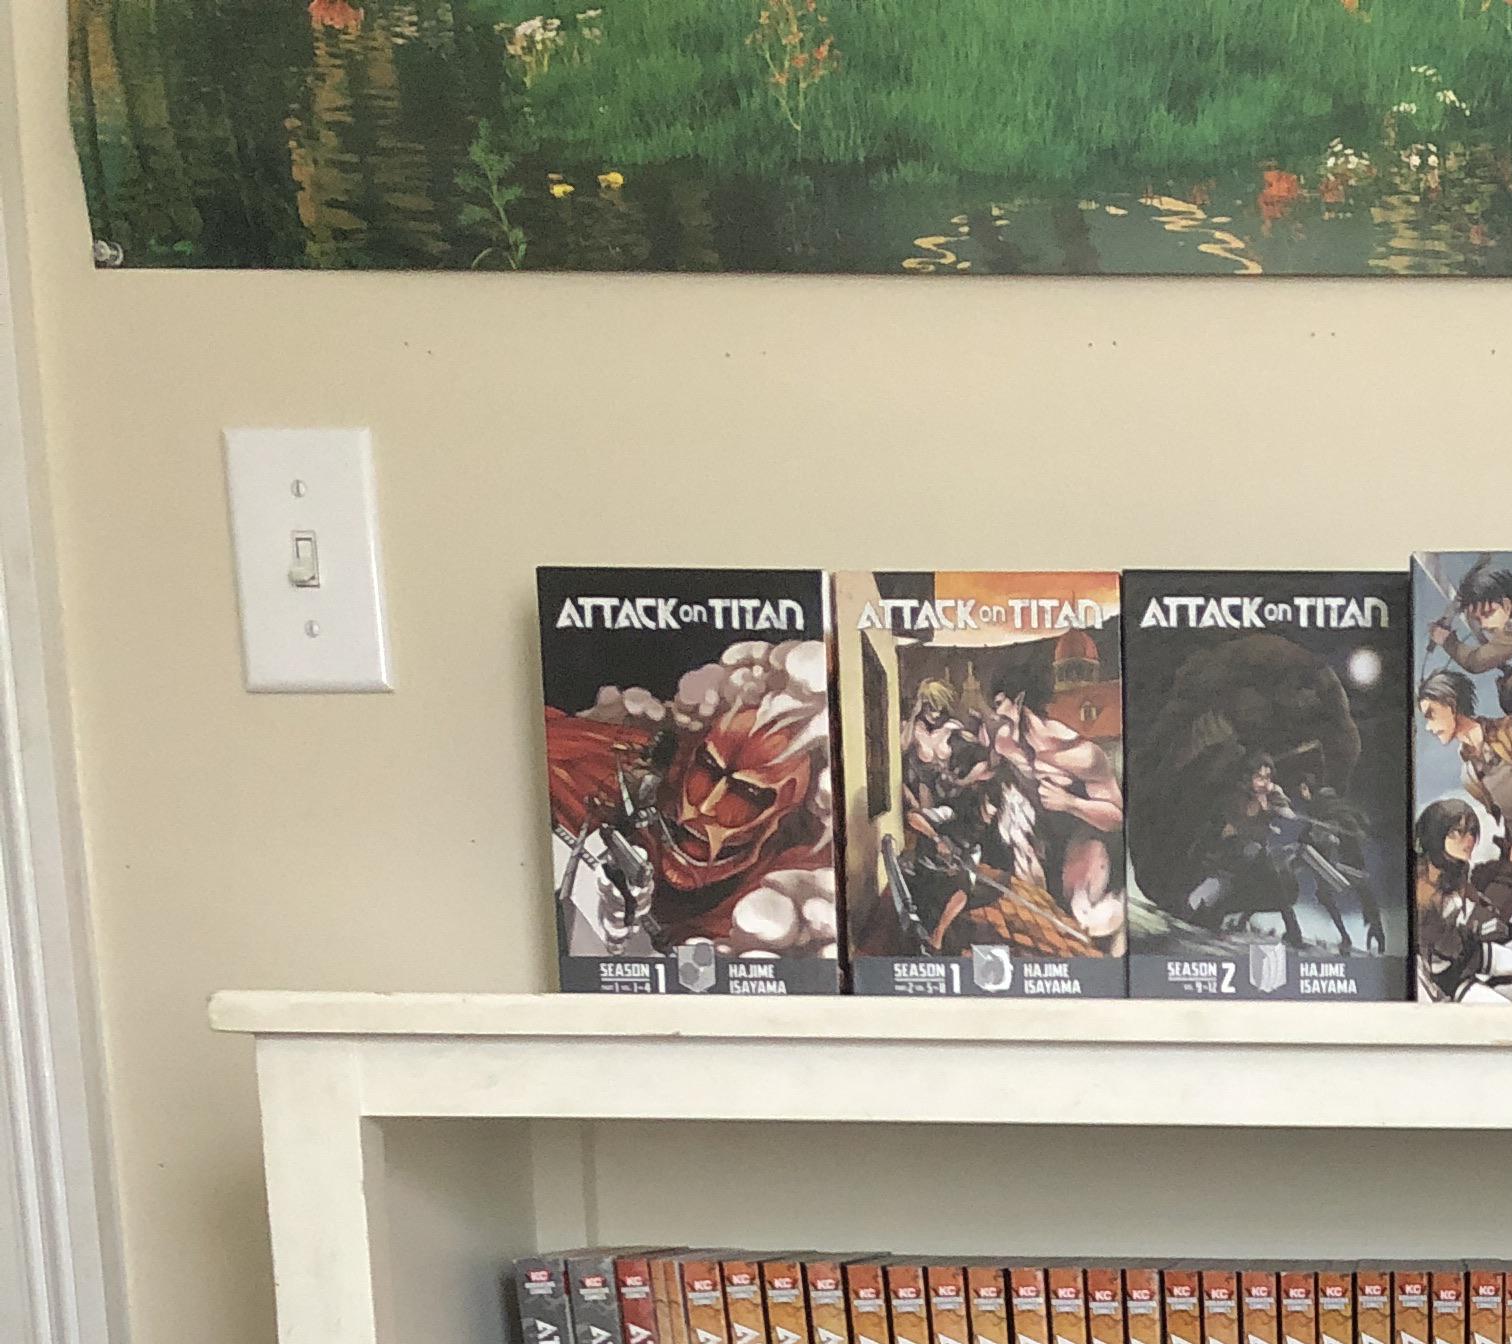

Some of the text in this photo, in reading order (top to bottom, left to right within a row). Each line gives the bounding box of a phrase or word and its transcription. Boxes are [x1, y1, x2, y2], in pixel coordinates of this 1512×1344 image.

[555, 597, 804, 630] ATTACK on TITAN
[857, 599, 1102, 629] ATTACK on TITAN
[1140, 597, 1389, 629] ATTACK on TITAN
[600, 963, 649, 977] SEASON
[655, 964, 666, 993] 1
[729, 964, 774, 978] HAJIME
[894, 963, 945, 977] SEASON
[950, 964, 961, 994] 1
[1024, 964, 1069, 977] HAJIME
[1167, 962, 1217, 976] SEASON
[1221, 963, 1236, 993] 2
[1301, 963, 1346, 977] HAJIME
[729, 981, 787, 994] ISAYAMA
[1024, 980, 1082, 994] ISAYAMA
[1301, 979, 1357, 994] ISAYAMA
